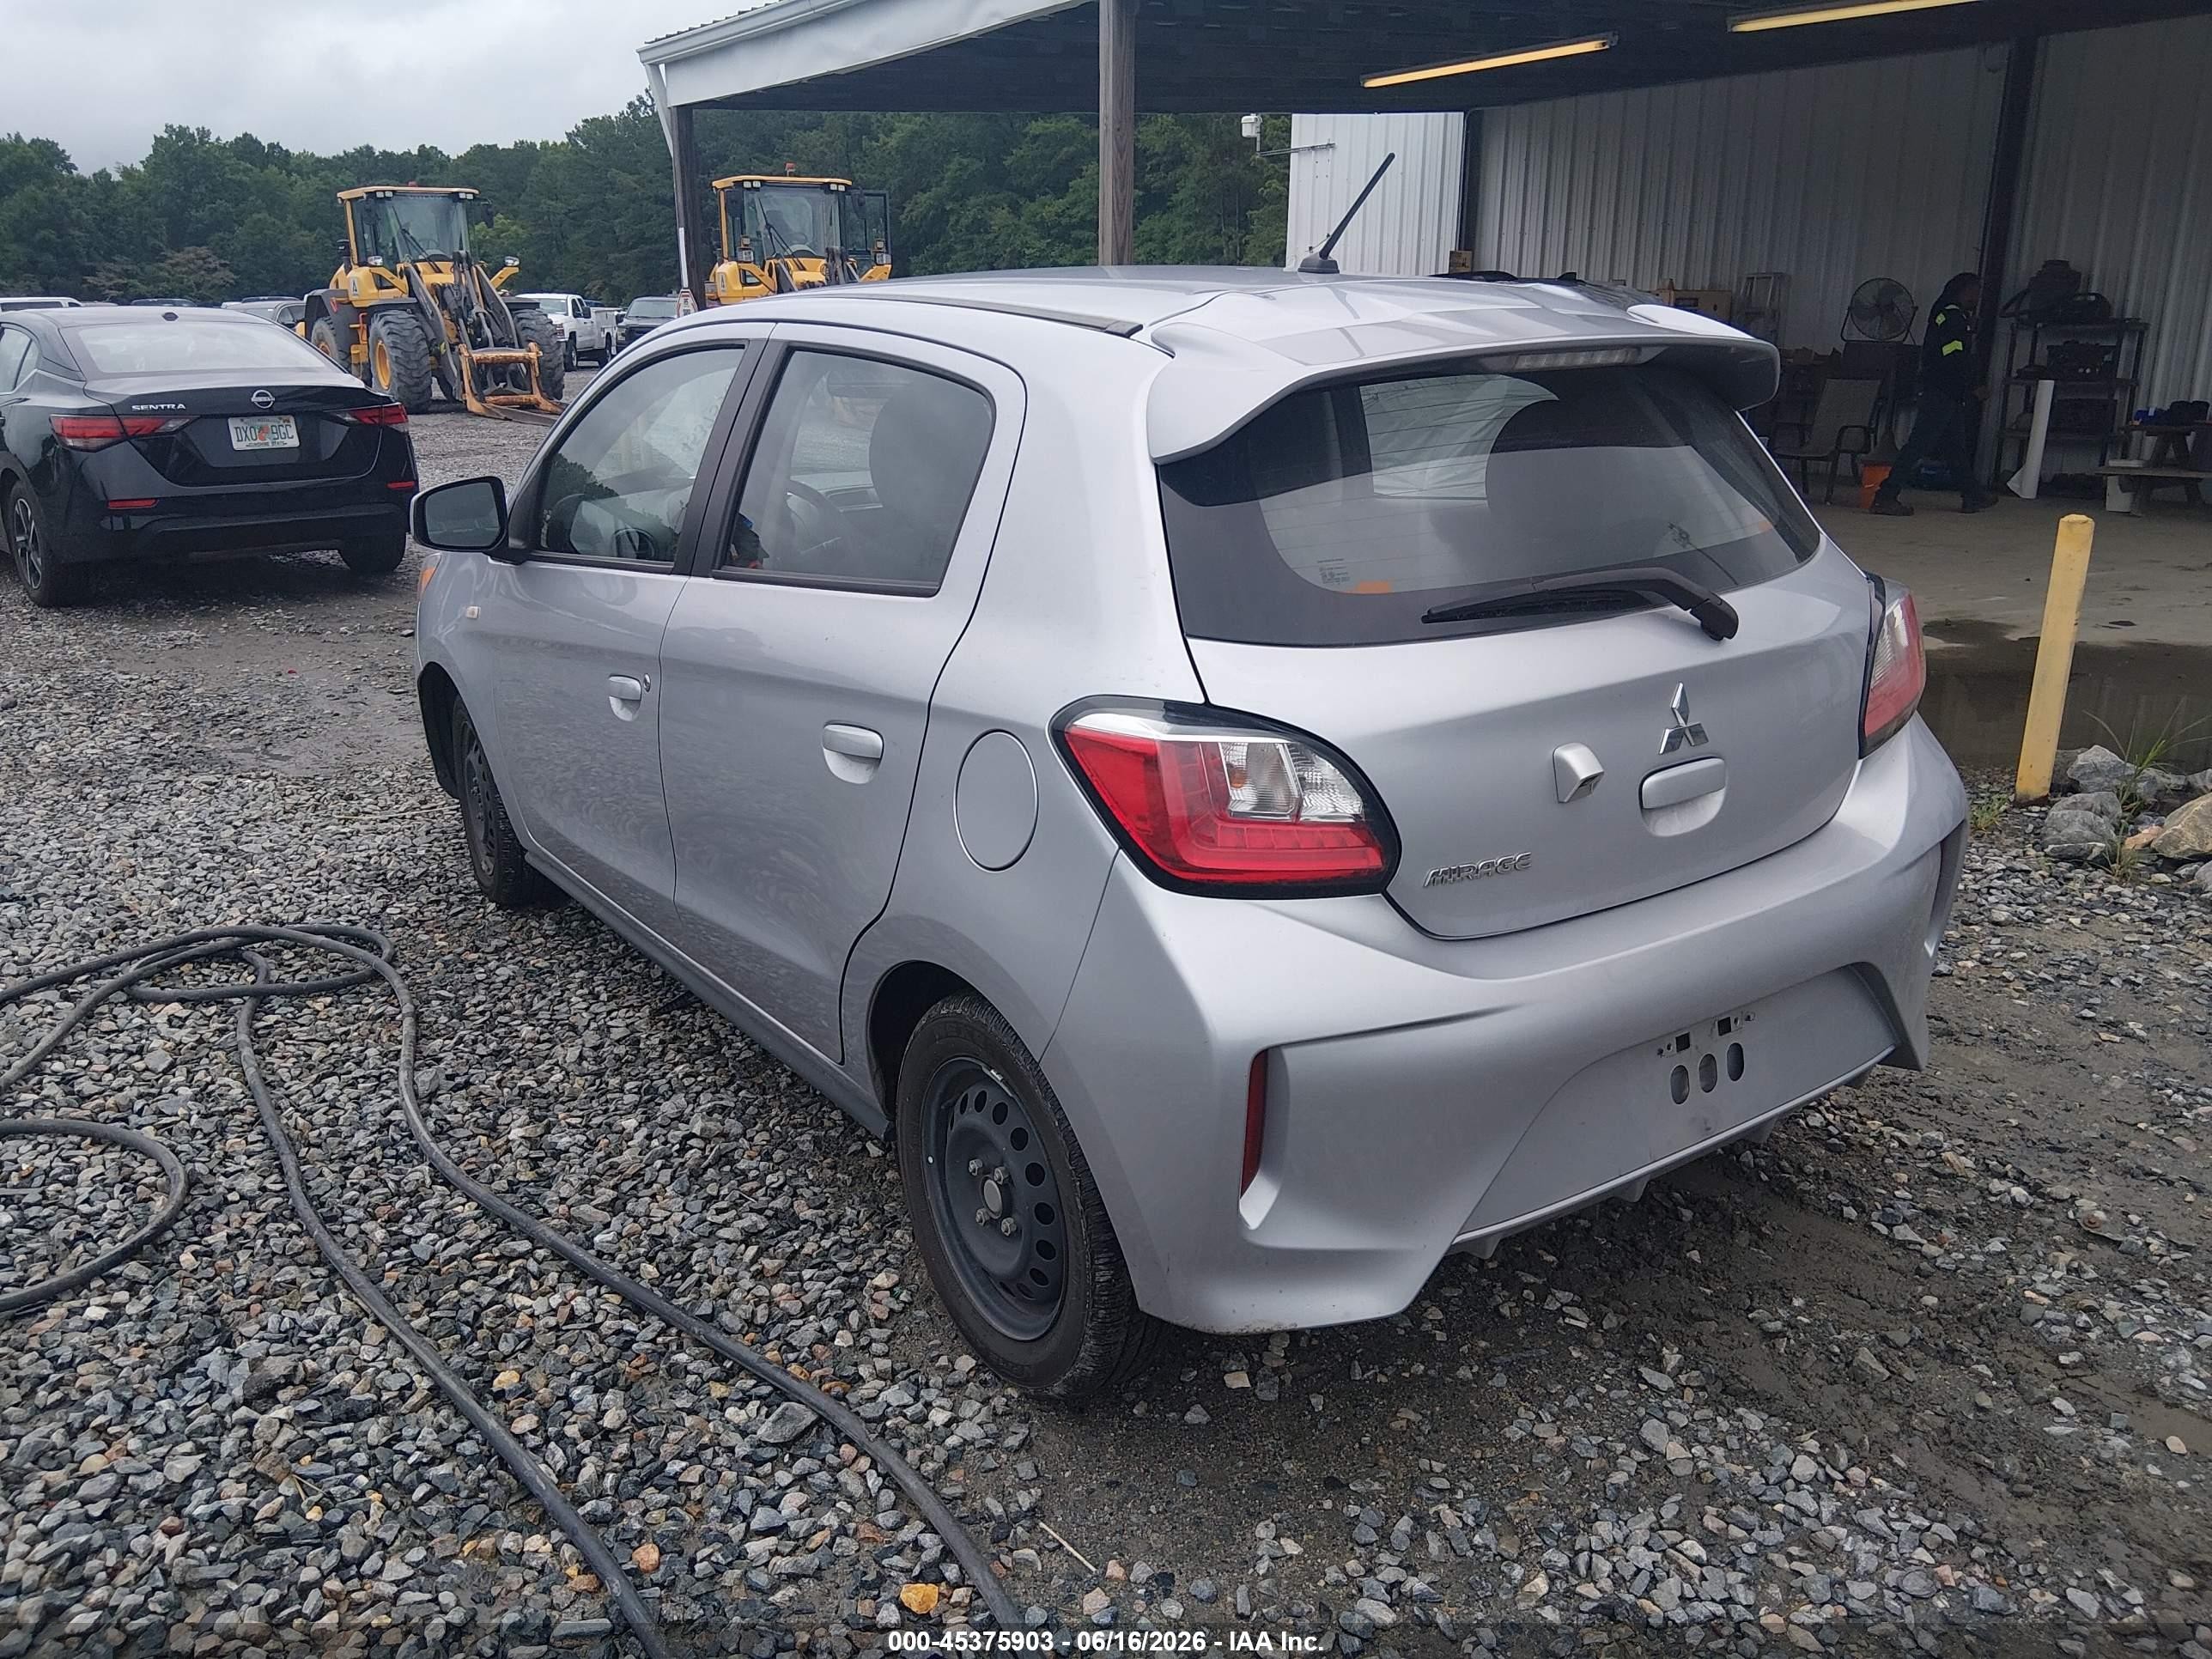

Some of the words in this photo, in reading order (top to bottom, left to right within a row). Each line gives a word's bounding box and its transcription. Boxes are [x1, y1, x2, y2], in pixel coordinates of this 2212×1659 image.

[131, 403, 186, 411] SENTRA
[270, 424, 295, 440] 9GC
[1424, 851, 1532, 887] MIRAGE
